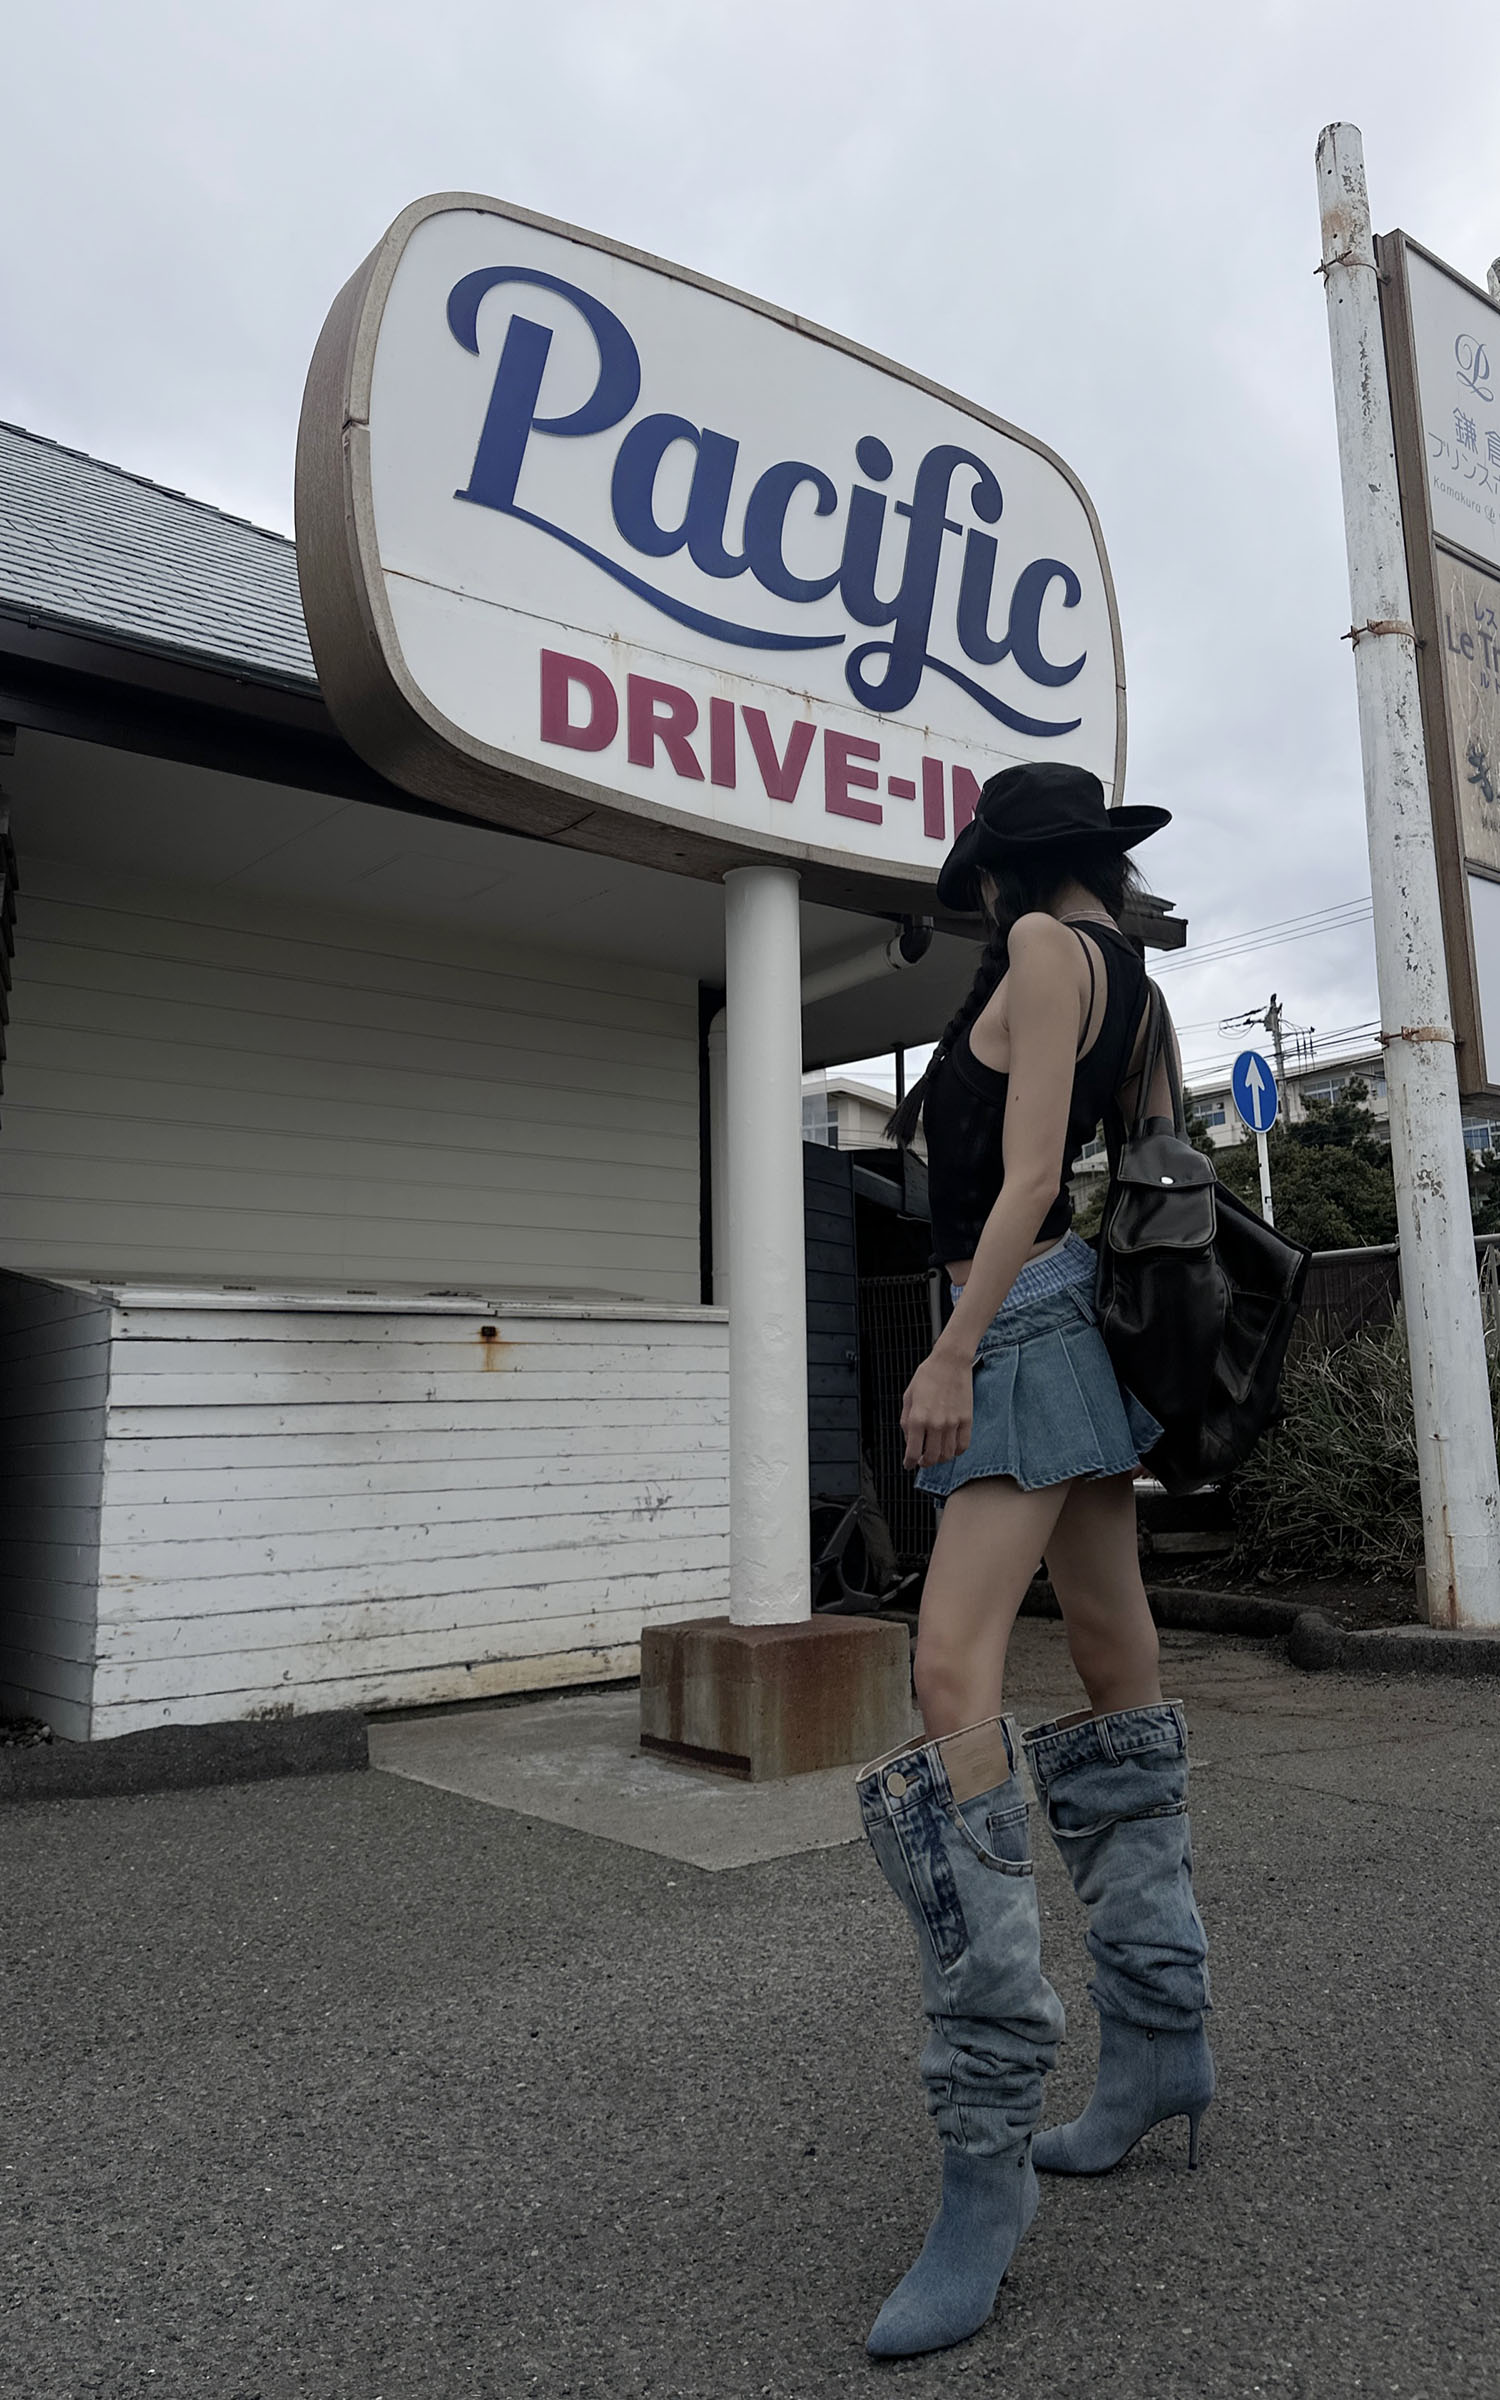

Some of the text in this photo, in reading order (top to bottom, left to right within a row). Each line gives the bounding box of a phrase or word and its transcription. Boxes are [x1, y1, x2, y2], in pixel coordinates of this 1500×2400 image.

[446, 265, 1087, 737] Pacific
[1433, 475, 1481, 514] Kamakura
[1446, 613, 1474, 661] Le
